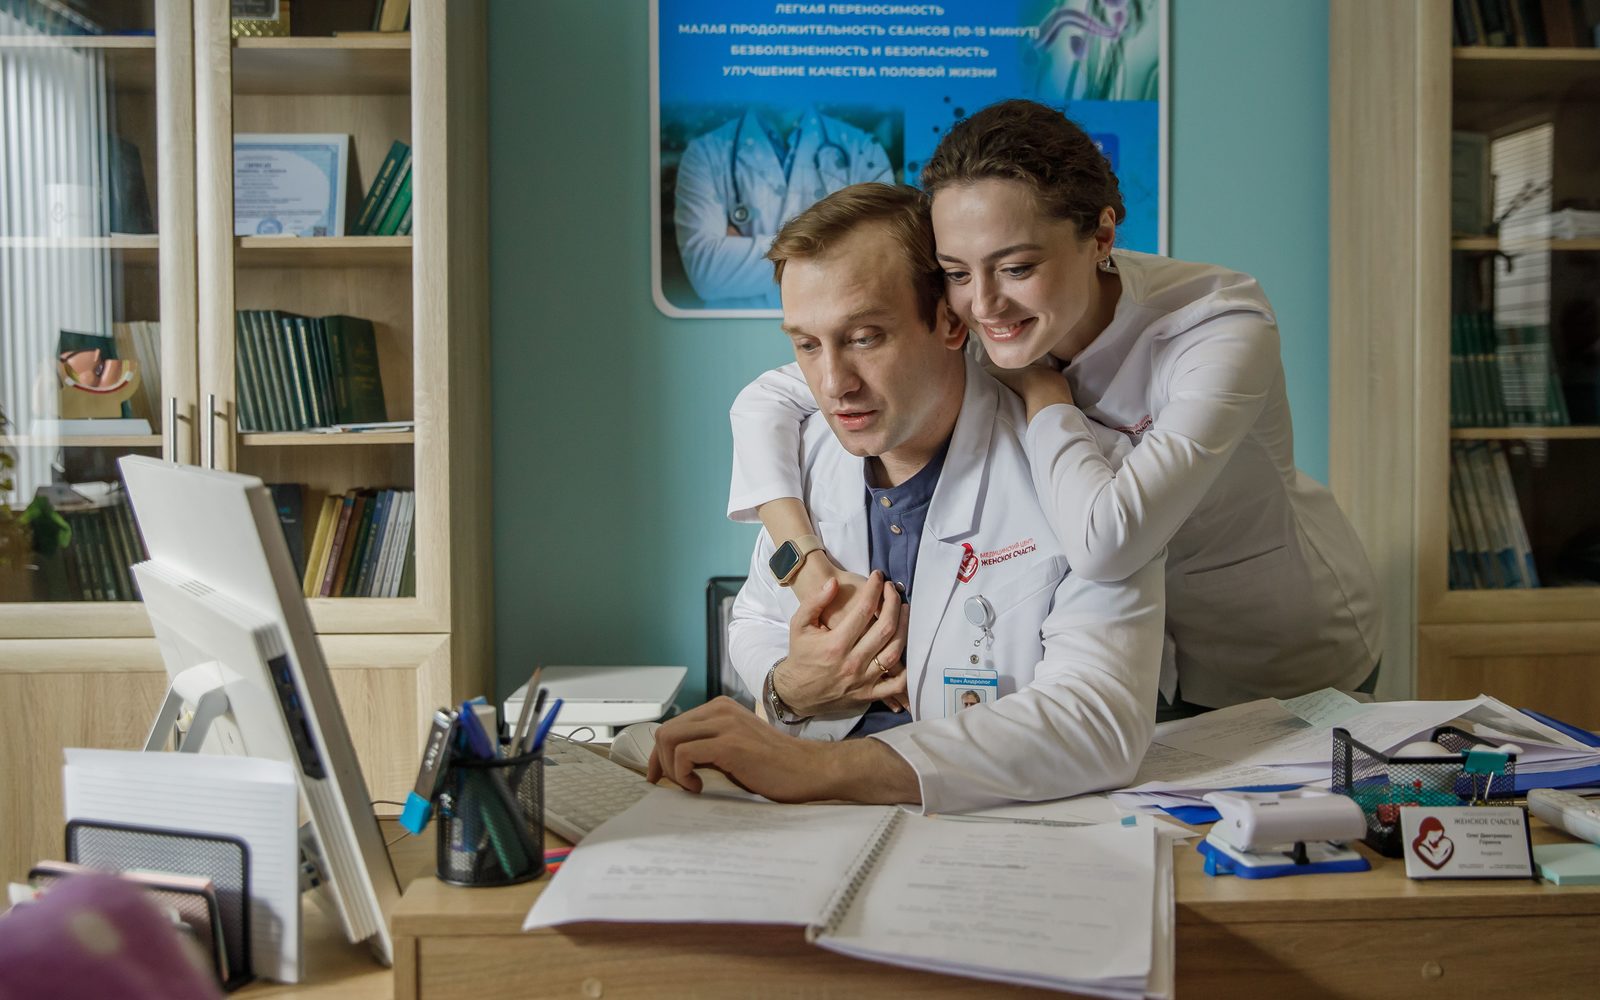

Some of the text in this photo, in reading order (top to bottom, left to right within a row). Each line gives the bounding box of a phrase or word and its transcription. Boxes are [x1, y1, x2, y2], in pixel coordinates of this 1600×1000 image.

[775, 3, 945, 16] ЛЕГКАЯ ПЕРЕНОСИМОСТЬ
[678, 24, 1040, 40] МАЛАЯ ПРОДОЛЖИТЕЛЬНОСТЬ СЕАНСОВ (10-15 МИНУТ)
[730, 44, 990, 58] БЕЗБОЛЕЗНЕННОСТЬ И БЕЗОПАСНОСТЬ
[722, 65, 998, 78] УЛУЧШЕНИЕ КАЧЕСТВА ПОЛОВОЙ ЖИЗНИ
[981, 552, 1012, 566] ЖЕНСКОЕ
